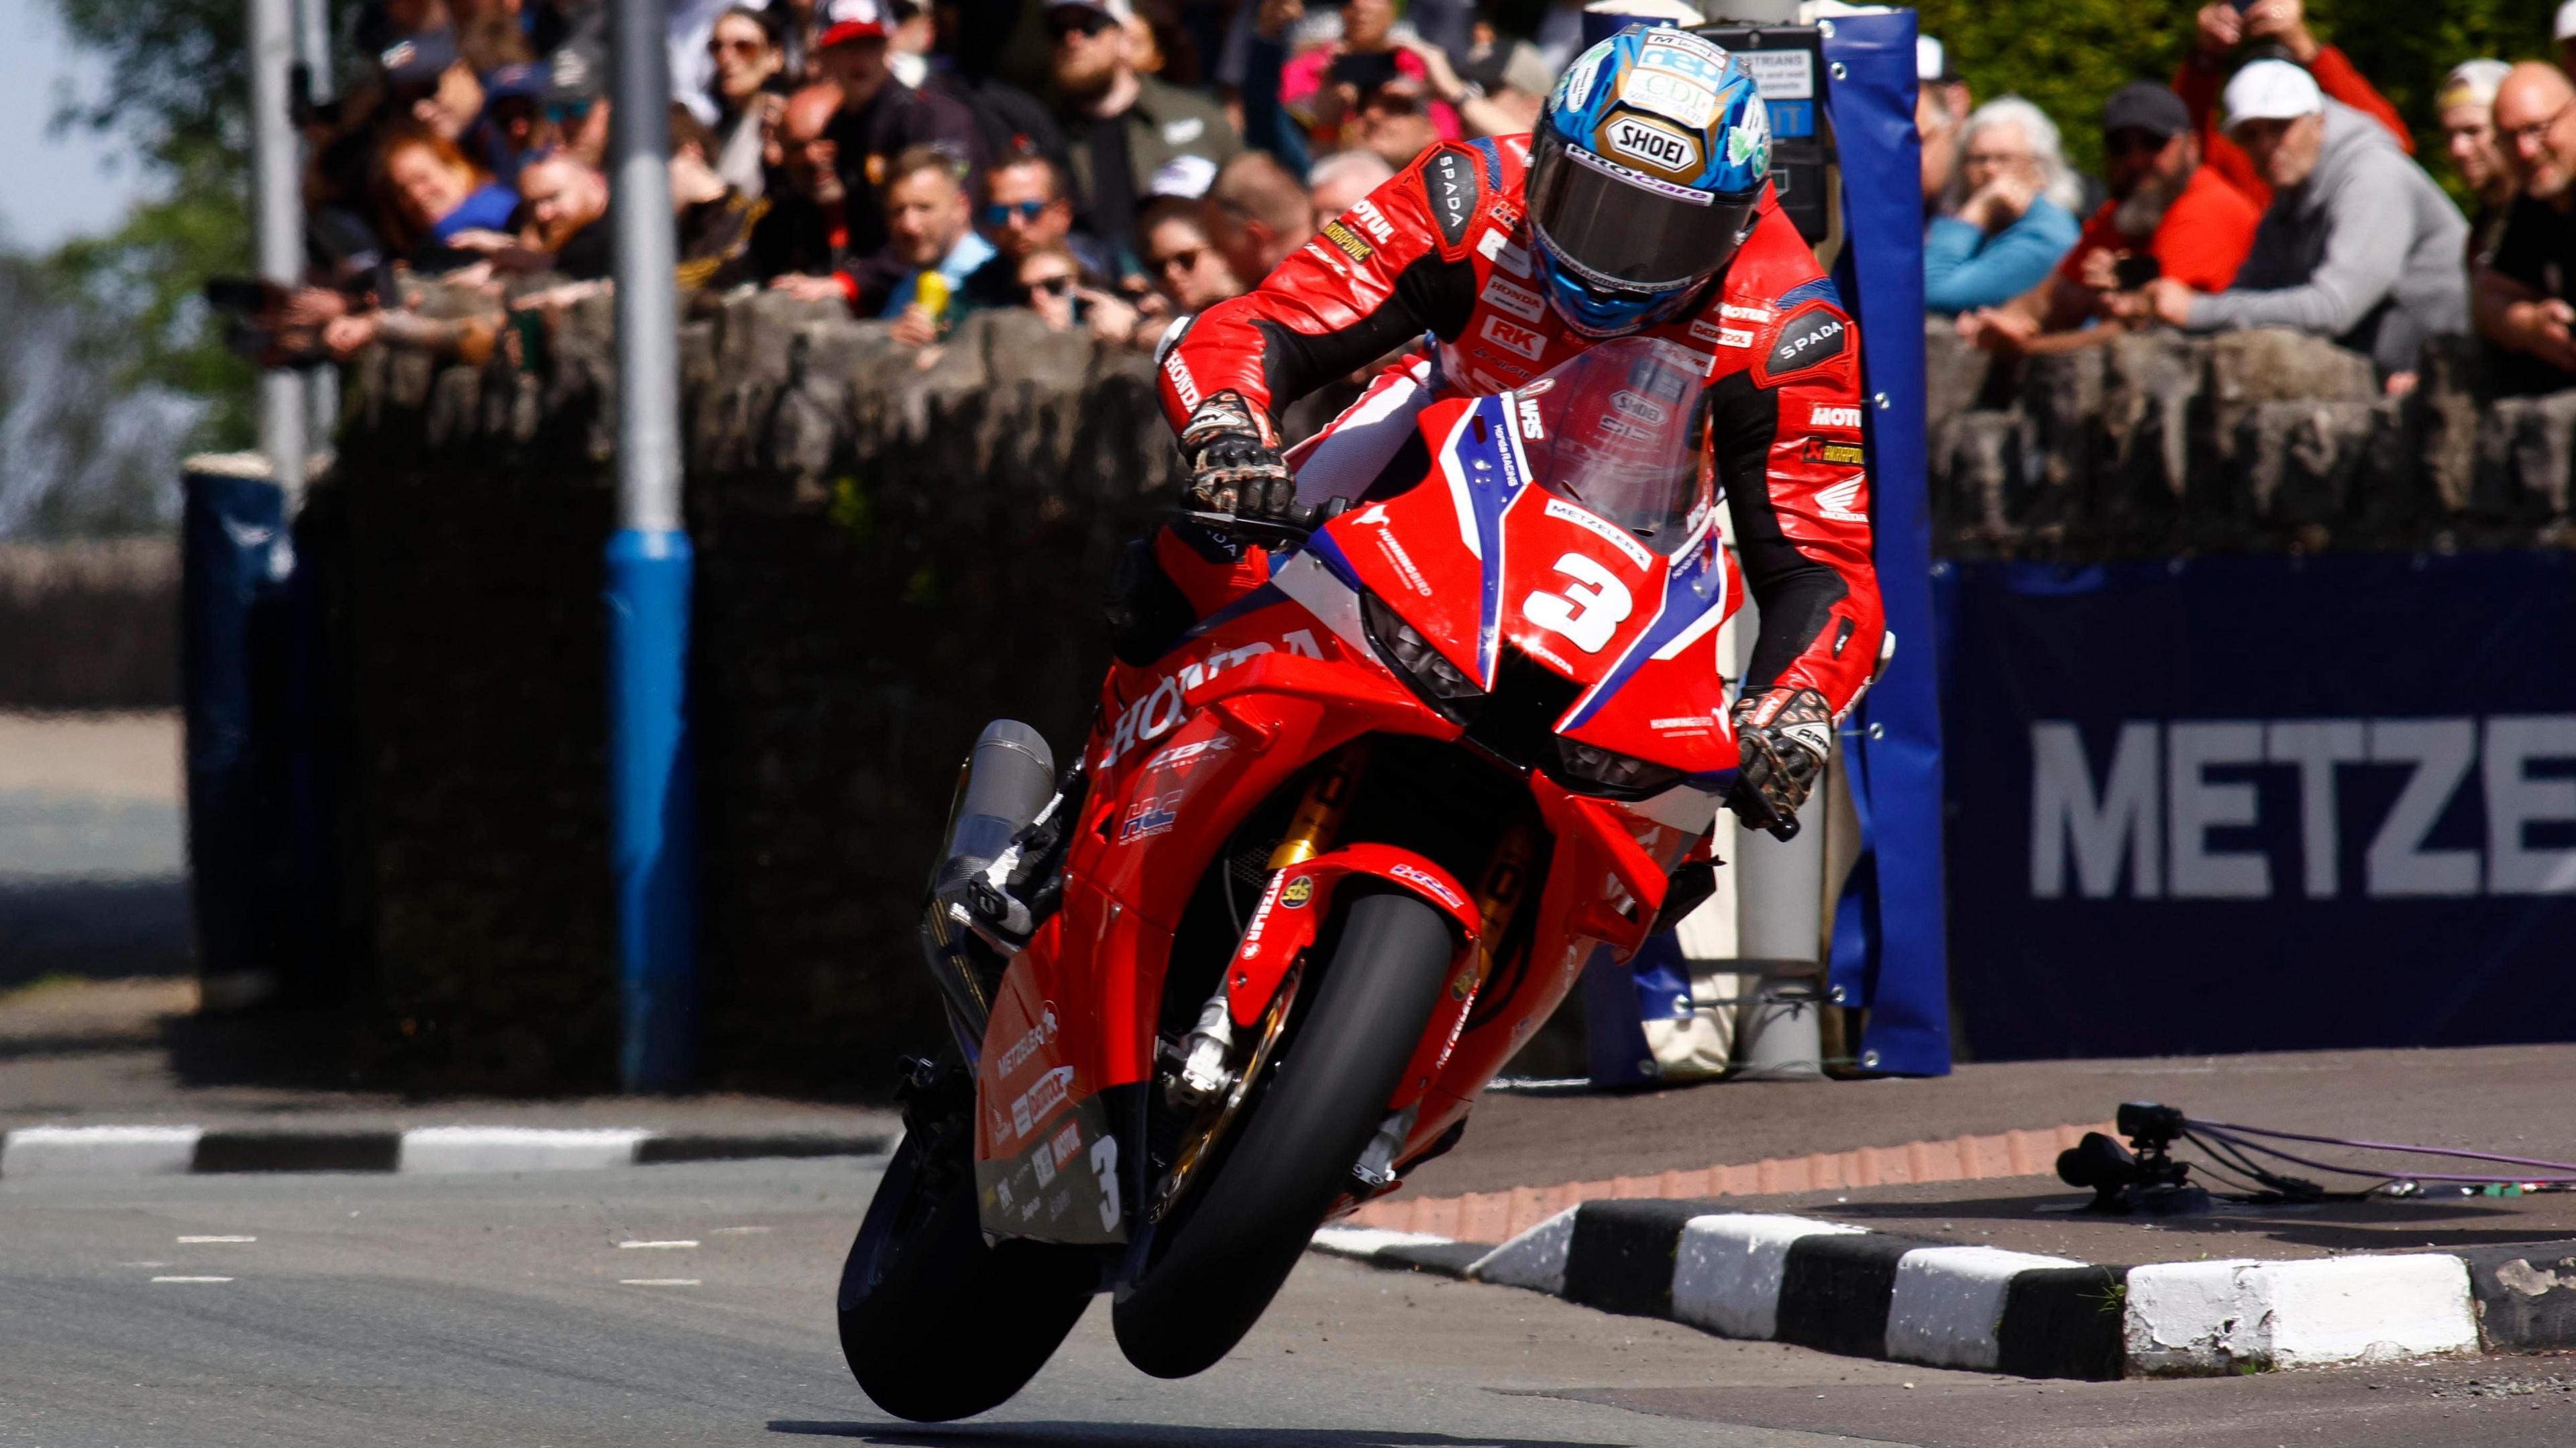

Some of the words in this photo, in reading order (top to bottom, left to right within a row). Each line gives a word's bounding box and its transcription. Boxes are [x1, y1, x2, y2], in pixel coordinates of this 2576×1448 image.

[1619, 125, 1684, 165] SHOEI
[1439, 156, 1464, 227] SPADA
[1491, 282, 1541, 309] HONDA
[1491, 320, 1538, 351] RK
[1779, 321, 1843, 359] SPADA
[1519, 398, 1545, 440] WRS
[1552, 504, 1635, 551] METZELER
[1522, 551, 1634, 655] 3
[2031, 714, 2576, 897] METZE
[1246, 868, 1287, 941] METZELER
[1090, 1134, 1121, 1233] 3
